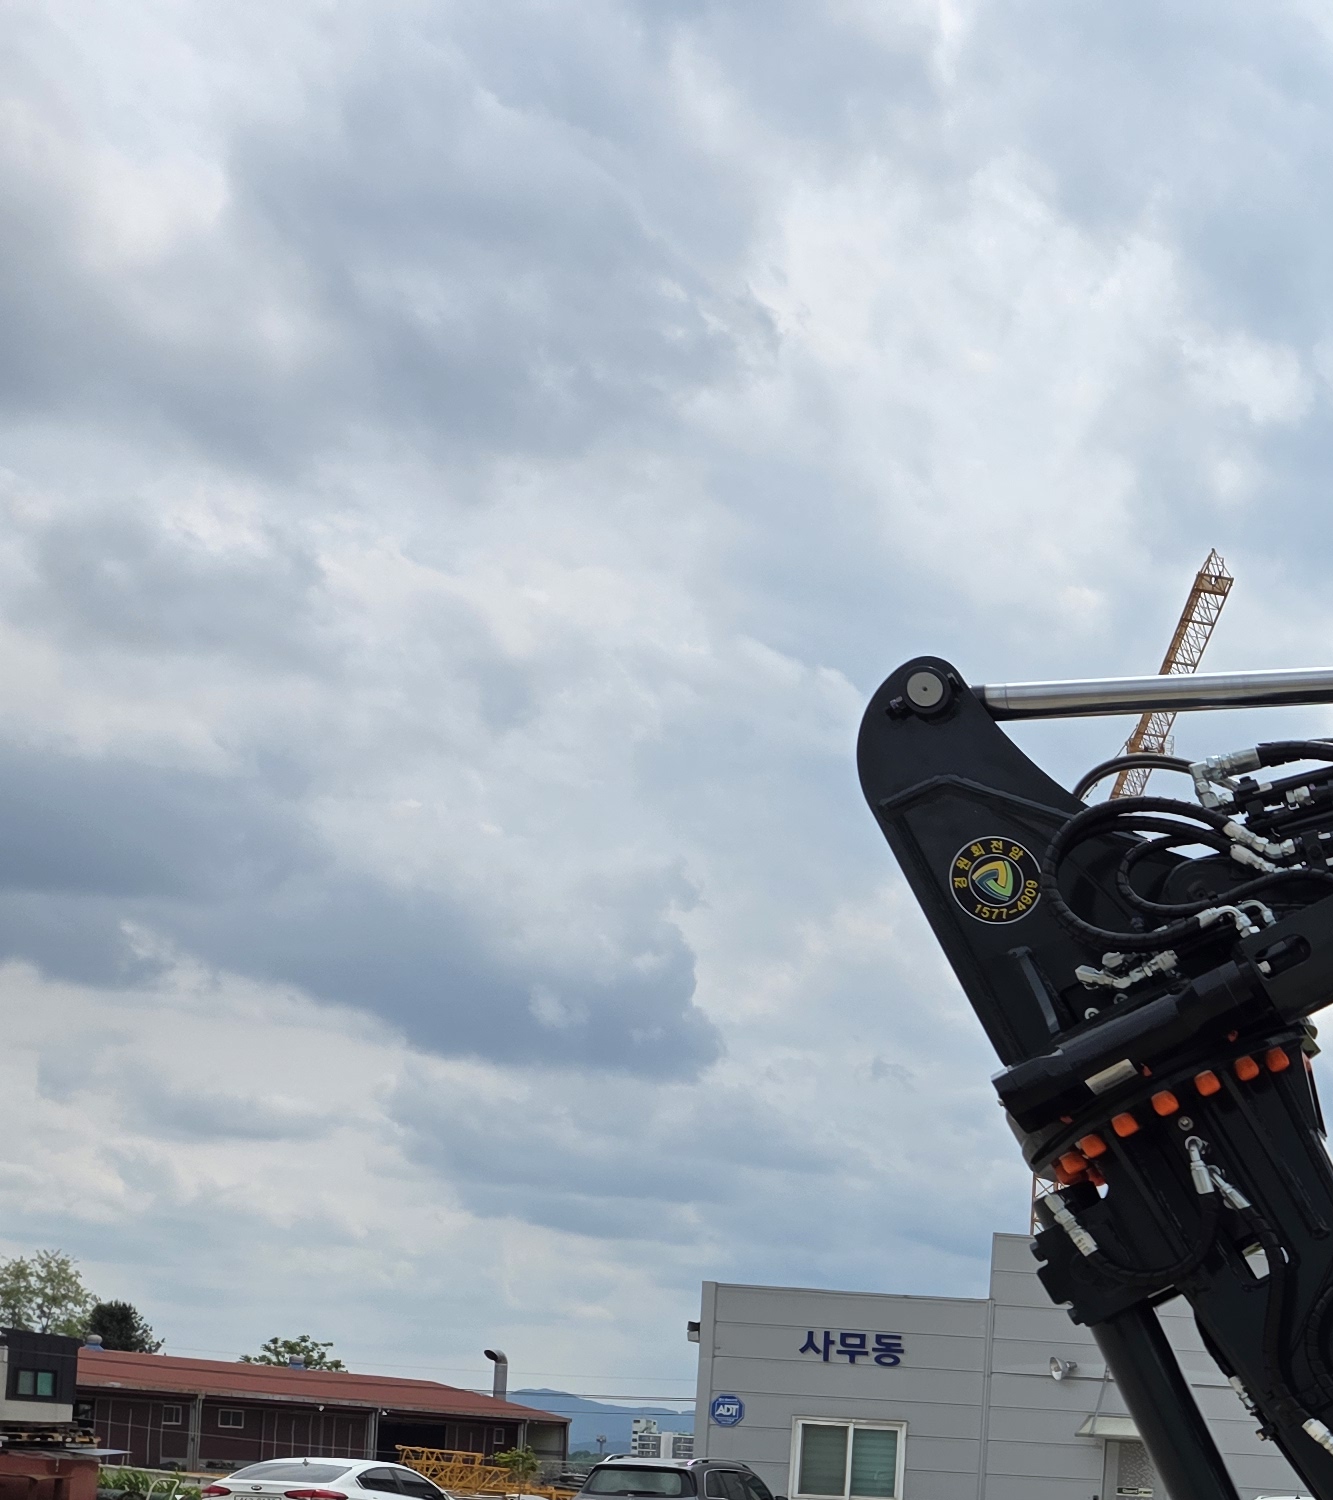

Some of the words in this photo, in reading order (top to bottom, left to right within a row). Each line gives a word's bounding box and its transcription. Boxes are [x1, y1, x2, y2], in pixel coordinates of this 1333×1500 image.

[974, 879, 1039, 920] 1577-4909
[799, 1330, 905, 1367] 사무동
[714, 1404, 740, 1416] ADT
